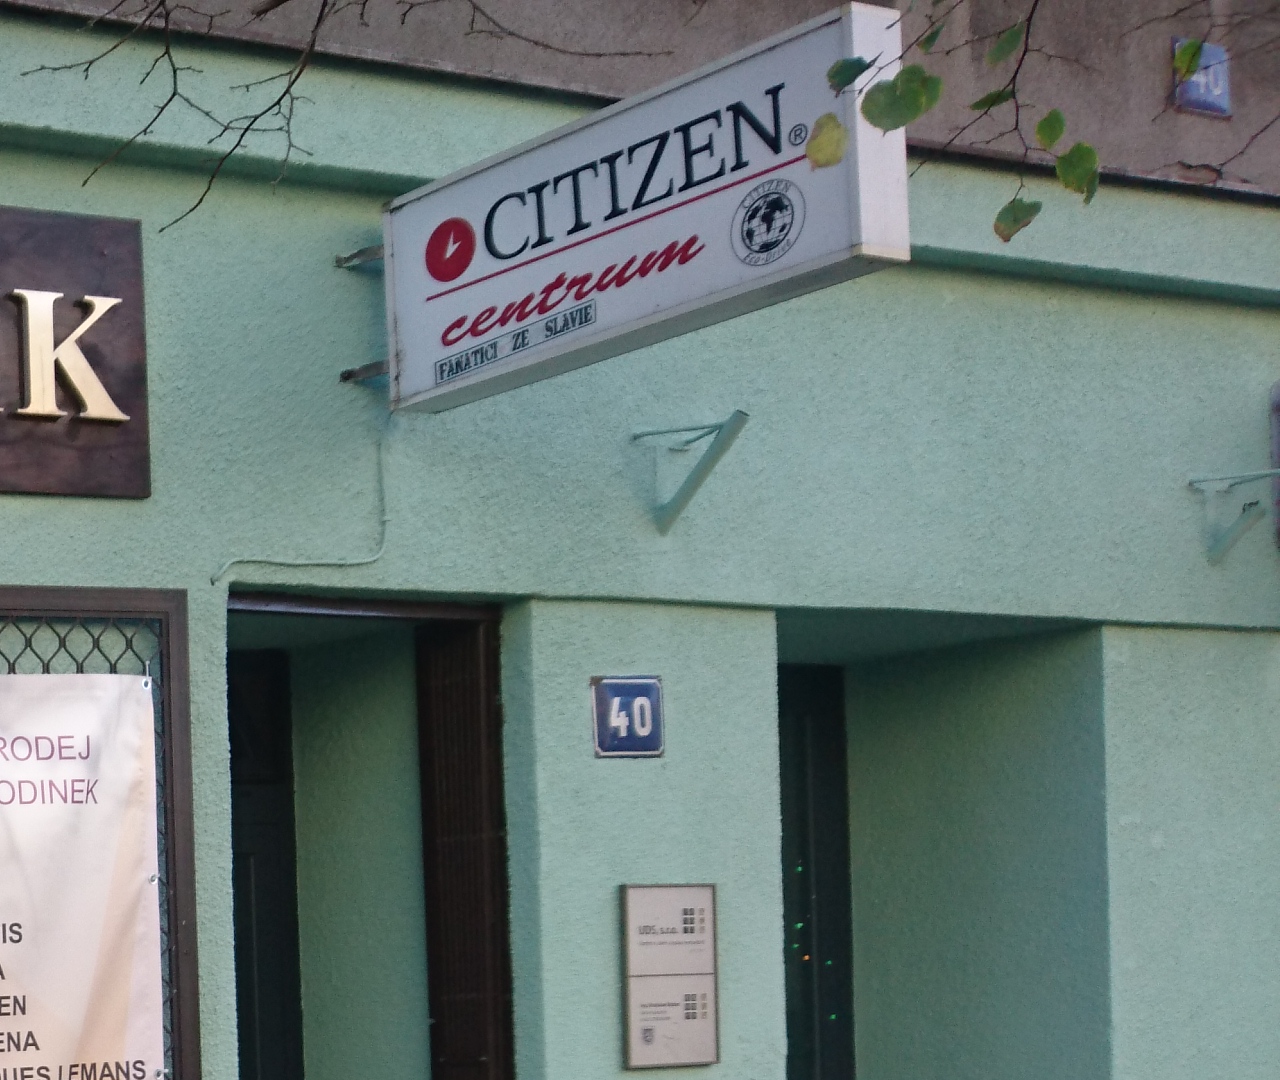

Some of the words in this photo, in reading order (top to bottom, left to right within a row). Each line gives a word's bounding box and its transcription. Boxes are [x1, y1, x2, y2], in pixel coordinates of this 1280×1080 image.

[483, 83, 786, 260] CITIZEN
[441, 234, 705, 347] centrum
[440, 340, 498, 381] FANATICI
[512, 328, 530, 352] ZE
[544, 303, 593, 339] SLAVIE
[608, 695, 654, 738] 40
